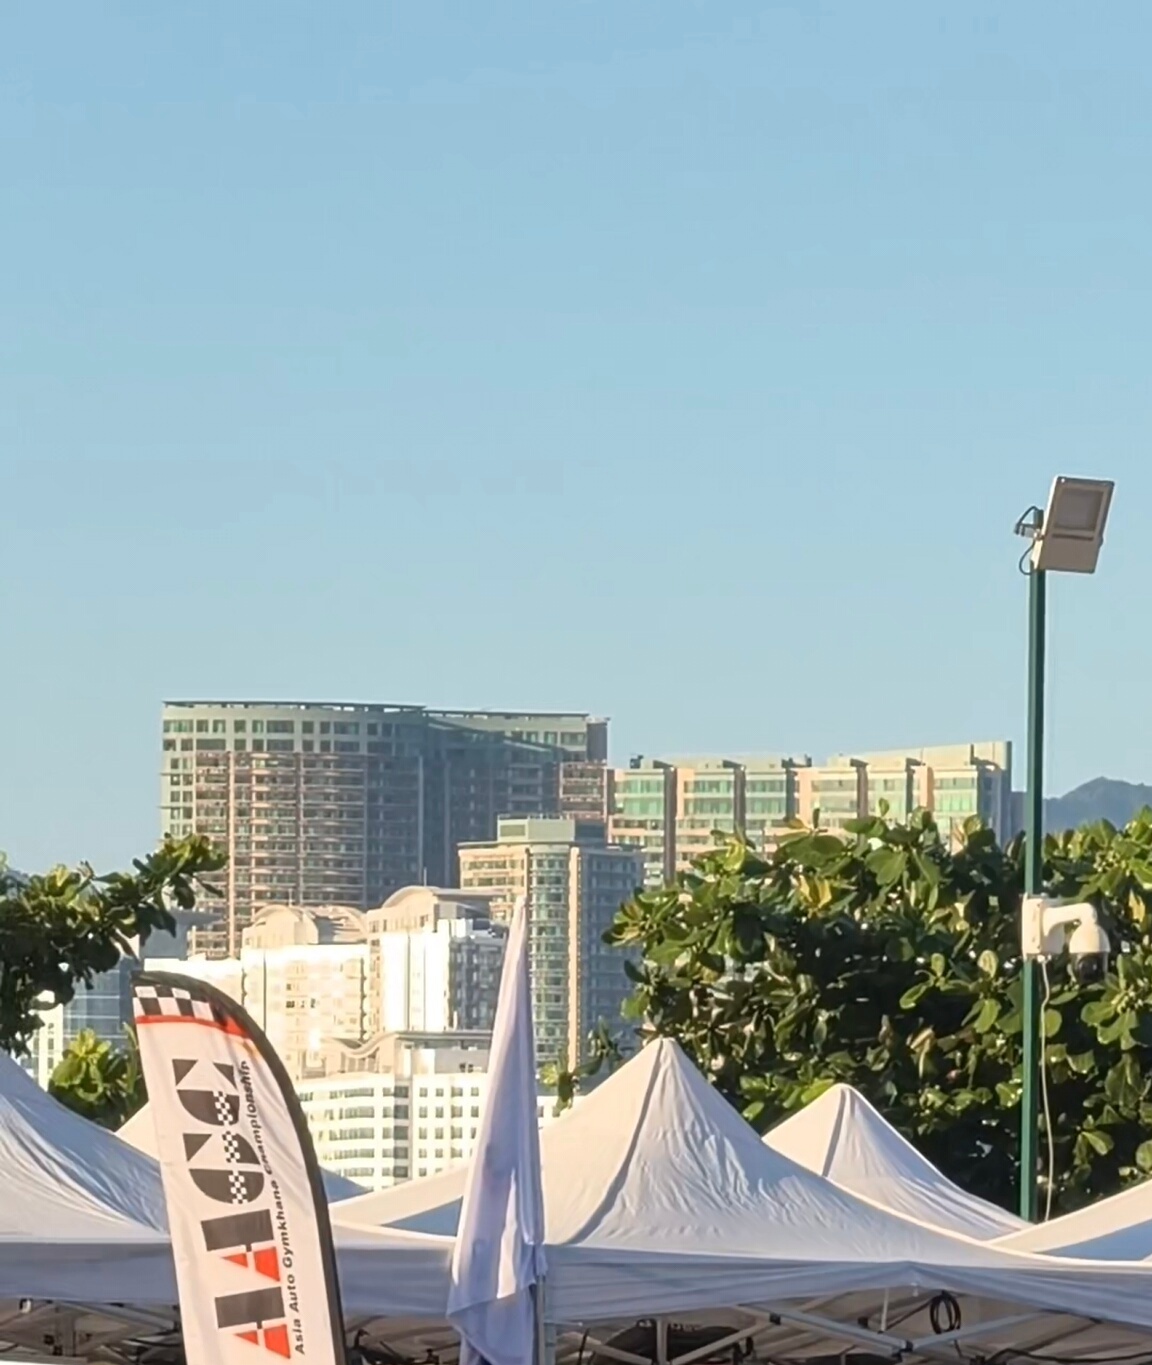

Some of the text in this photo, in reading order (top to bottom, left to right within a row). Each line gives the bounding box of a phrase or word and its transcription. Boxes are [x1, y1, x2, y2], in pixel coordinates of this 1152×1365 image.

[240, 1059, 306, 1356] Asia Auto Gymkhana Championship
